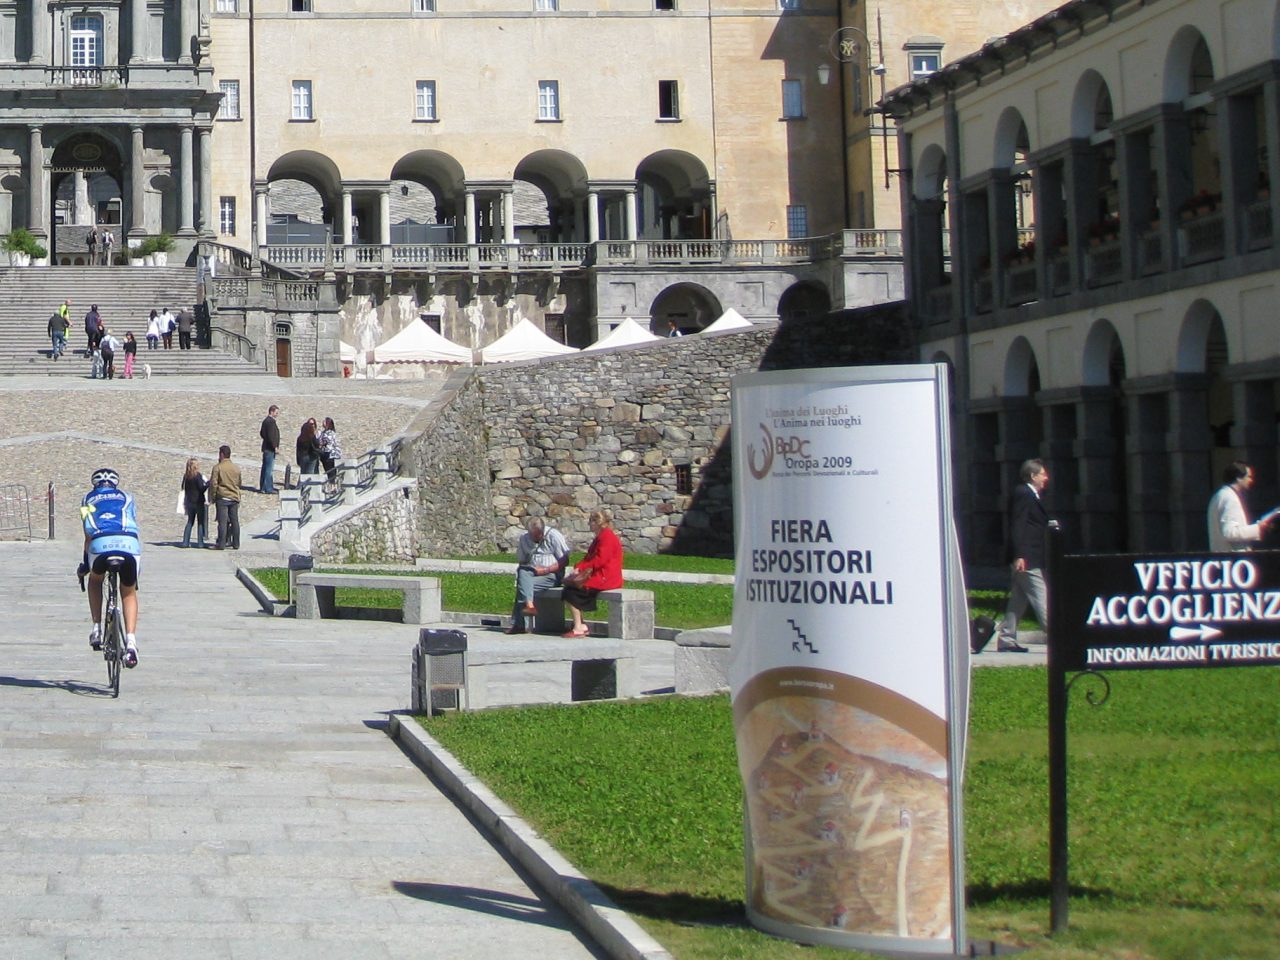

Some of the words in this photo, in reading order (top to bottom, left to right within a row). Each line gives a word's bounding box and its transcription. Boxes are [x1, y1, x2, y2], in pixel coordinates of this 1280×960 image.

[796, 406, 810, 417] dei
[813, 405, 848, 417] Luoghi
[810, 416, 825, 427] nei
[828, 416, 861, 428] luoghi
[785, 457, 819, 471] Oropa
[822, 456, 852, 468] 2009
[771, 519, 834, 544] FIERA
[752, 549, 872, 574] ESPOSITORI
[1134, 559, 1257, 591] VFFICIO
[746, 579, 893, 605] ISTITUZIONALI
[1086, 644, 1207, 664] INFORMAZIONI
